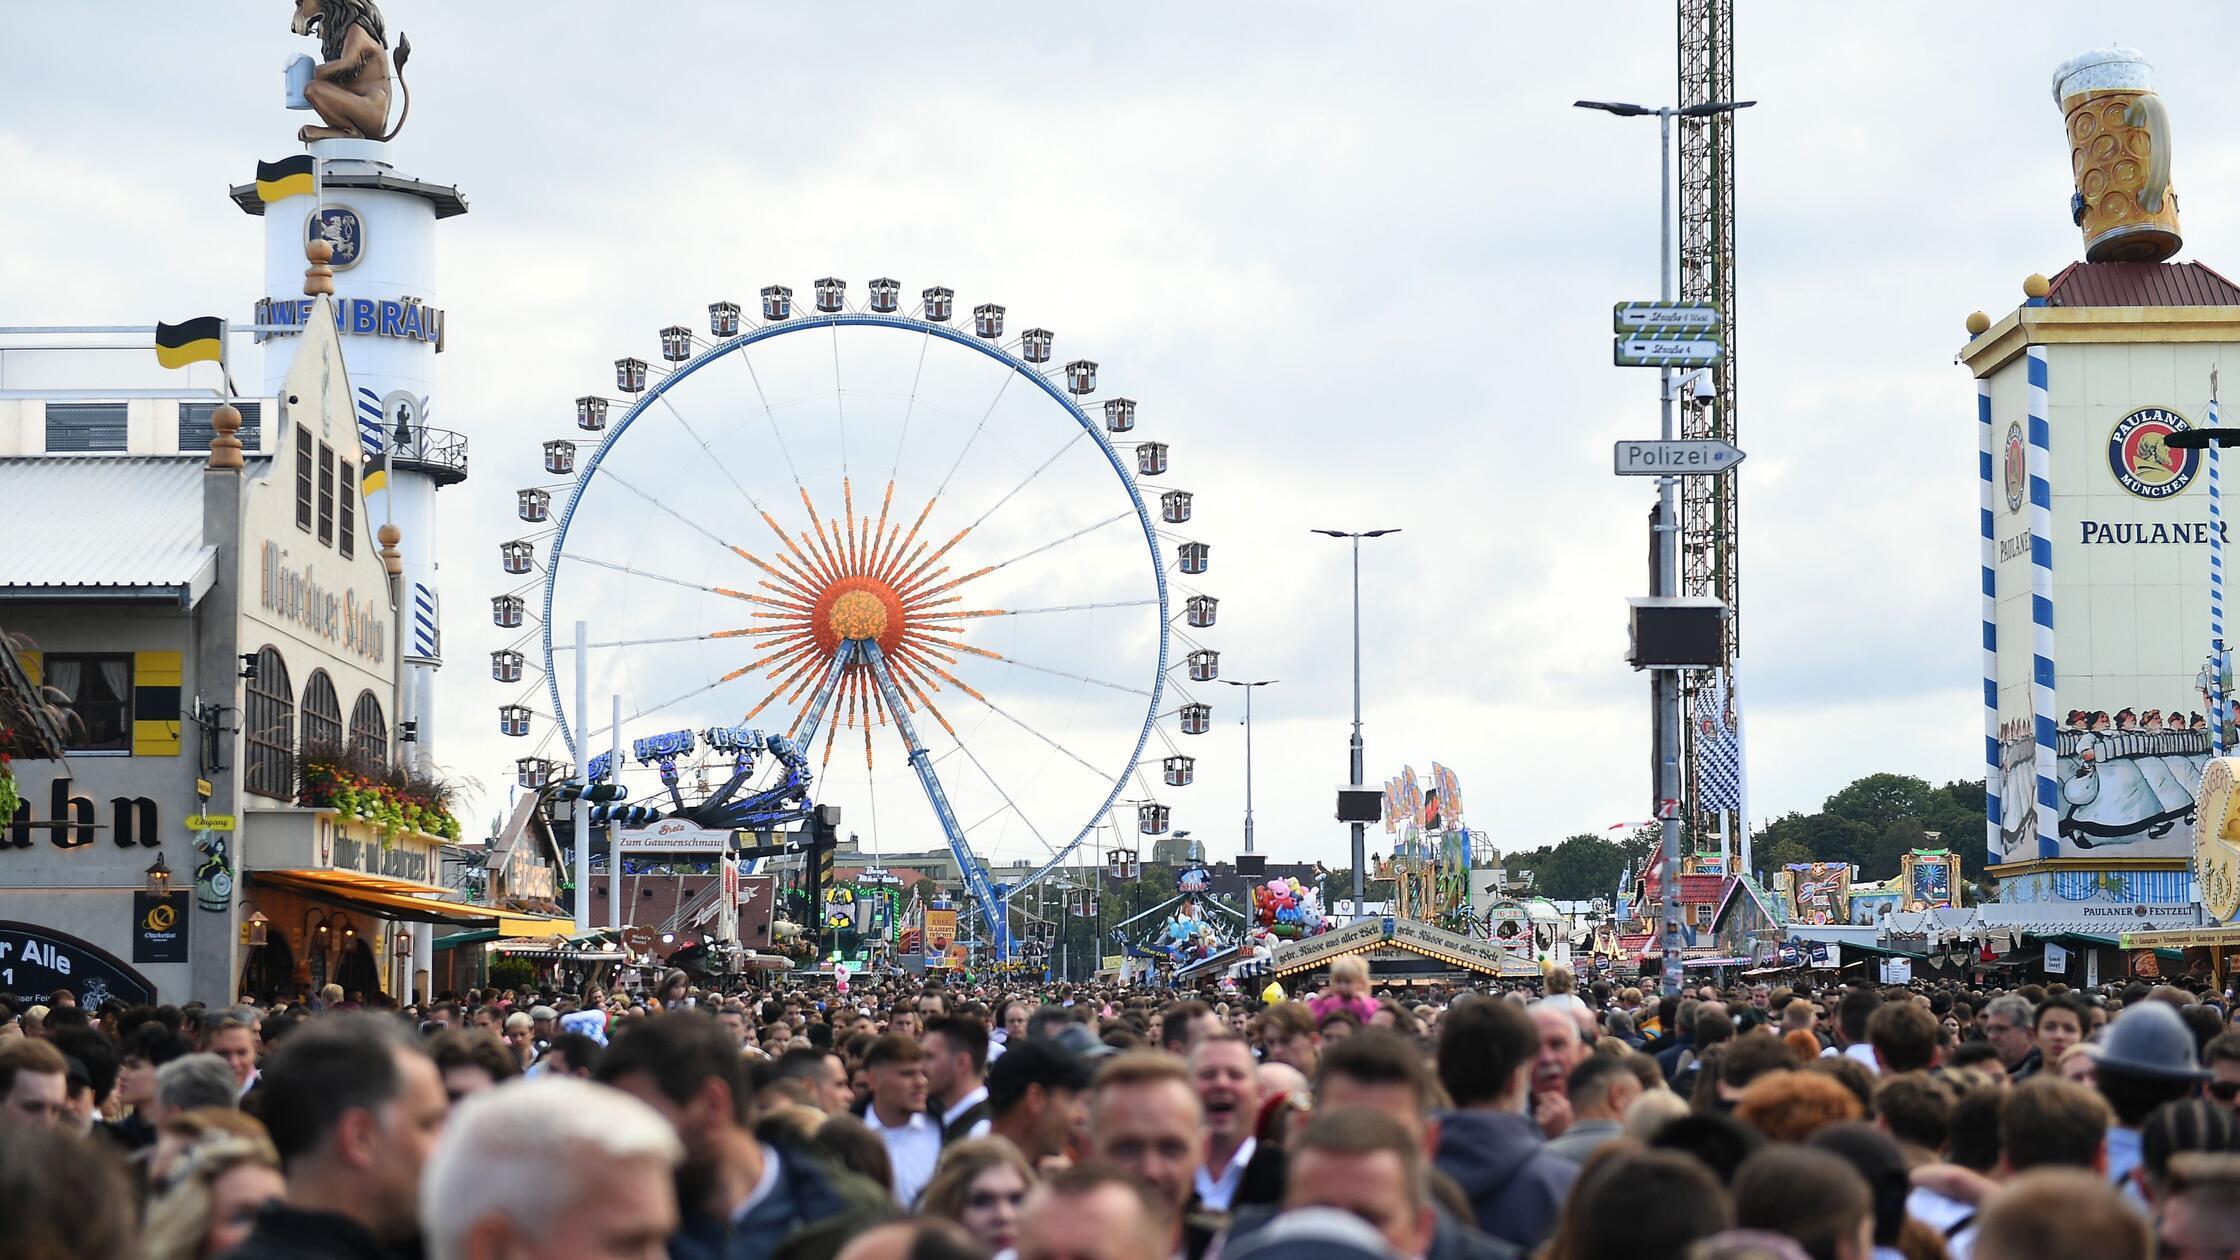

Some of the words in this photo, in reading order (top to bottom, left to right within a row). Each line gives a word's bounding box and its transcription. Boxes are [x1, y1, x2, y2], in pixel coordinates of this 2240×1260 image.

[2112, 409, 2192, 444] PAULANE
[1629, 446, 1708, 465] Polizei
[2120, 473, 2190, 497] MÜNCHEN
[2080, 520, 2231, 544] PAULANER
[620, 838, 641, 847] Zum
[644, 837, 725, 847] Gaumenschmaus
[2083, 907, 2133, 916] PAULANER
[2149, 907, 2193, 916] FESTZELT
[21, 939, 71, 975] Alle
